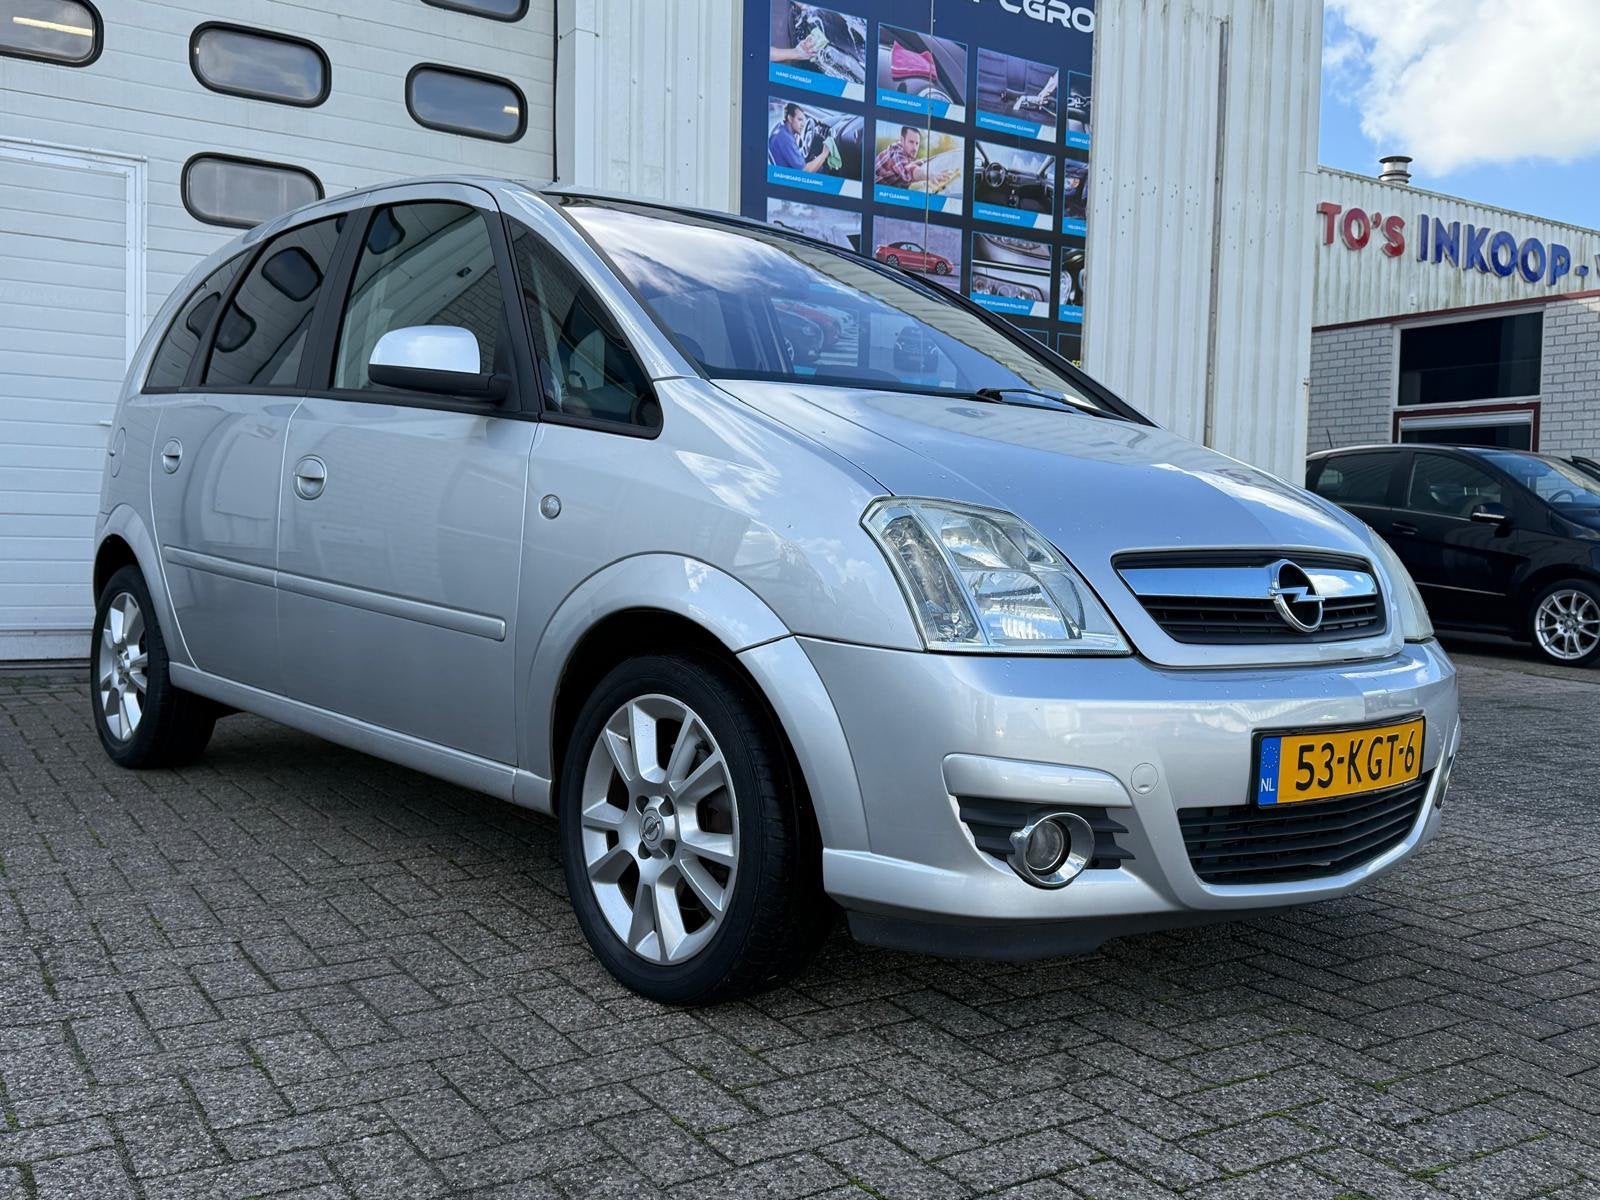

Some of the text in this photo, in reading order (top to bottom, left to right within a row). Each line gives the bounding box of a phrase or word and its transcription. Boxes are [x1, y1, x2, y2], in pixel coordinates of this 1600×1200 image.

[972, 0, 1095, 33] CGRO
[1316, 202, 1405, 258] TO'S
[1295, 728, 1415, 791] 53-KGT-6
[1260, 777, 1275, 792] NL
